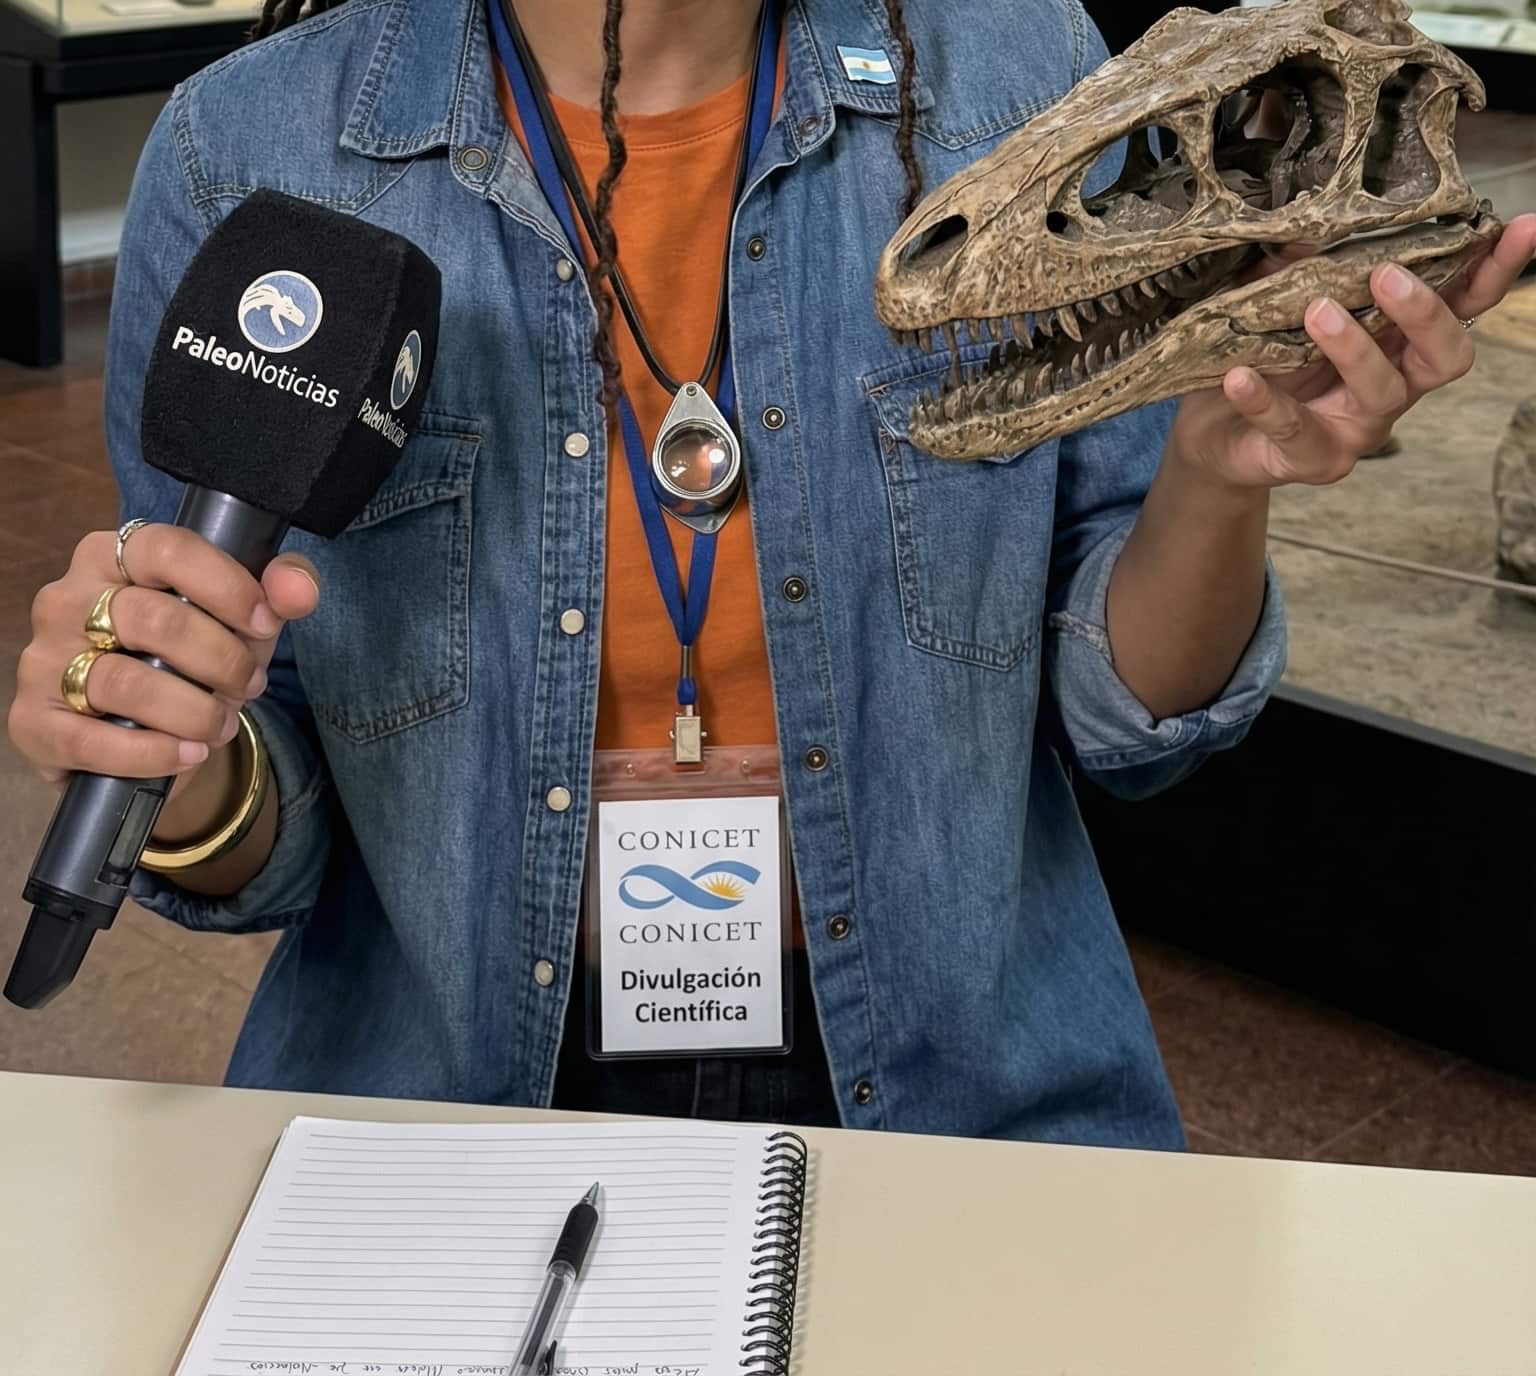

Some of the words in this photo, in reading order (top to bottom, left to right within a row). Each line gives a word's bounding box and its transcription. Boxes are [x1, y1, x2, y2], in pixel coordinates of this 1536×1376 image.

[171, 326, 341, 409] PaleoNoticias
[618, 828, 761, 852] CONICET
[619, 921, 763, 945] CONICET
[620, 966, 762, 994] Divulgación
[634, 1000, 748, 1025] Científica
